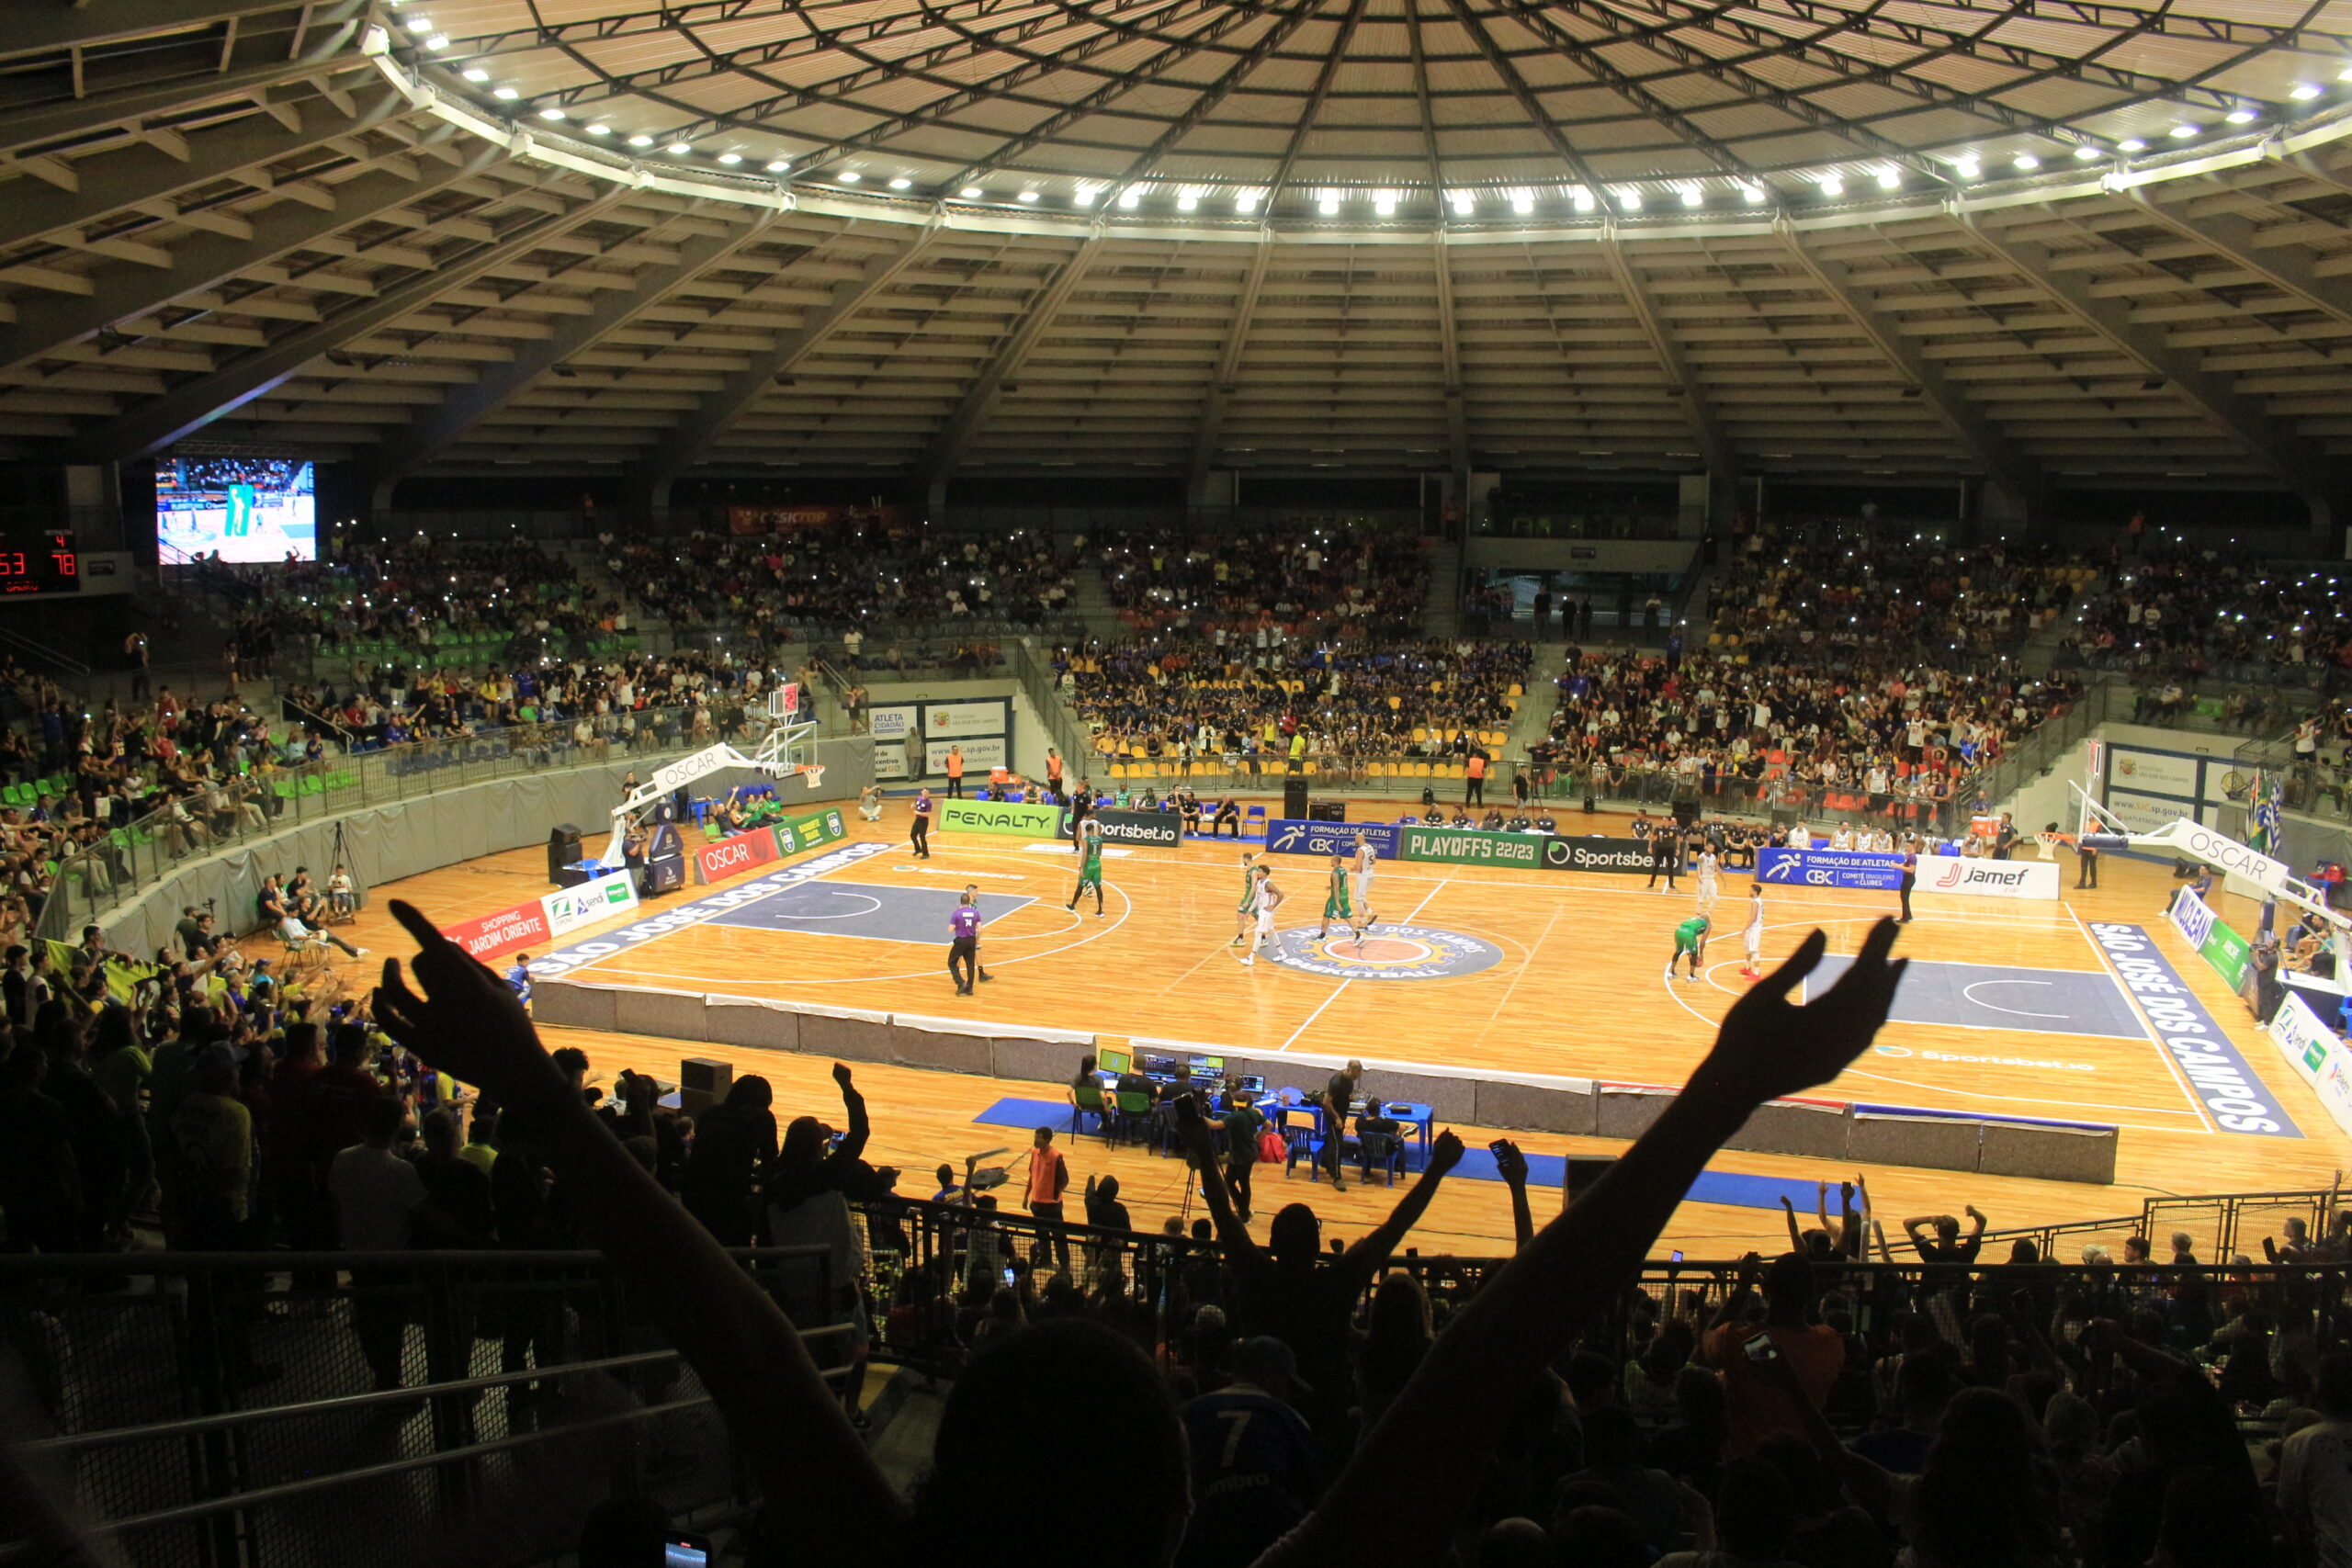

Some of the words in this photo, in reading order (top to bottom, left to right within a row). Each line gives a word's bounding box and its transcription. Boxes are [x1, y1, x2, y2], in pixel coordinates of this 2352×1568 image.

[760, 512, 827, 524] DSKTOP
[56, 536, 65, 547] 4
[51, 553, 75, 575] 78
[875, 714, 903, 722] ATLETA
[875, 721, 905, 729] CIDADÃO
[665, 752, 717, 784] OSCAR
[946, 809, 1050, 829] PENALTY
[1101, 823, 1175, 840] ortsbet.io
[1310, 826, 1349, 836] FORMAÇÃO
[1361, 829, 1391, 837] ATLETAS
[1309, 839, 1334, 853] CBC
[1410, 834, 1493, 858] PLAYOFFS
[1496, 842, 1534, 860] 22/23
[2190, 832, 2267, 880] OSCAR
[706, 843, 750, 871] OSCAR
[1574, 848, 1679, 868] Sportsbe.i
[1806, 855, 1849, 867] FORMAÇÃO
[1861, 859, 1896, 867] ATLETAS
[1805, 869, 1833, 885] CBC
[1963, 867, 2030, 886] jamef
[526, 942, 620, 974] SÃO
[616, 907, 708, 942] JOSÉ
[700, 883, 781, 907] DOS
[770, 842, 889, 882] CAMPOS
[586, 892, 604, 908] sendi
[481, 910, 521, 933] SHOPPING
[965, 919, 972, 927] 74
[468, 931, 502, 955] JARDIM
[502, 917, 542, 942] ORIENTE
[1385, 926, 1429, 936] DOS
[1430, 932, 1487, 953] CAMPOS
[2090, 922, 2148, 952] SÃO
[1283, 958, 1450, 977] BASKETBALL
[2110, 953, 2188, 994] JOSÉ
[2139, 997, 2207, 1034] DOS
[1921, 1050, 2095, 1071] Sportsbet.io
[2166, 1037, 2281, 1133] CAMPOS
[1216, 1410, 1253, 1468] 7
